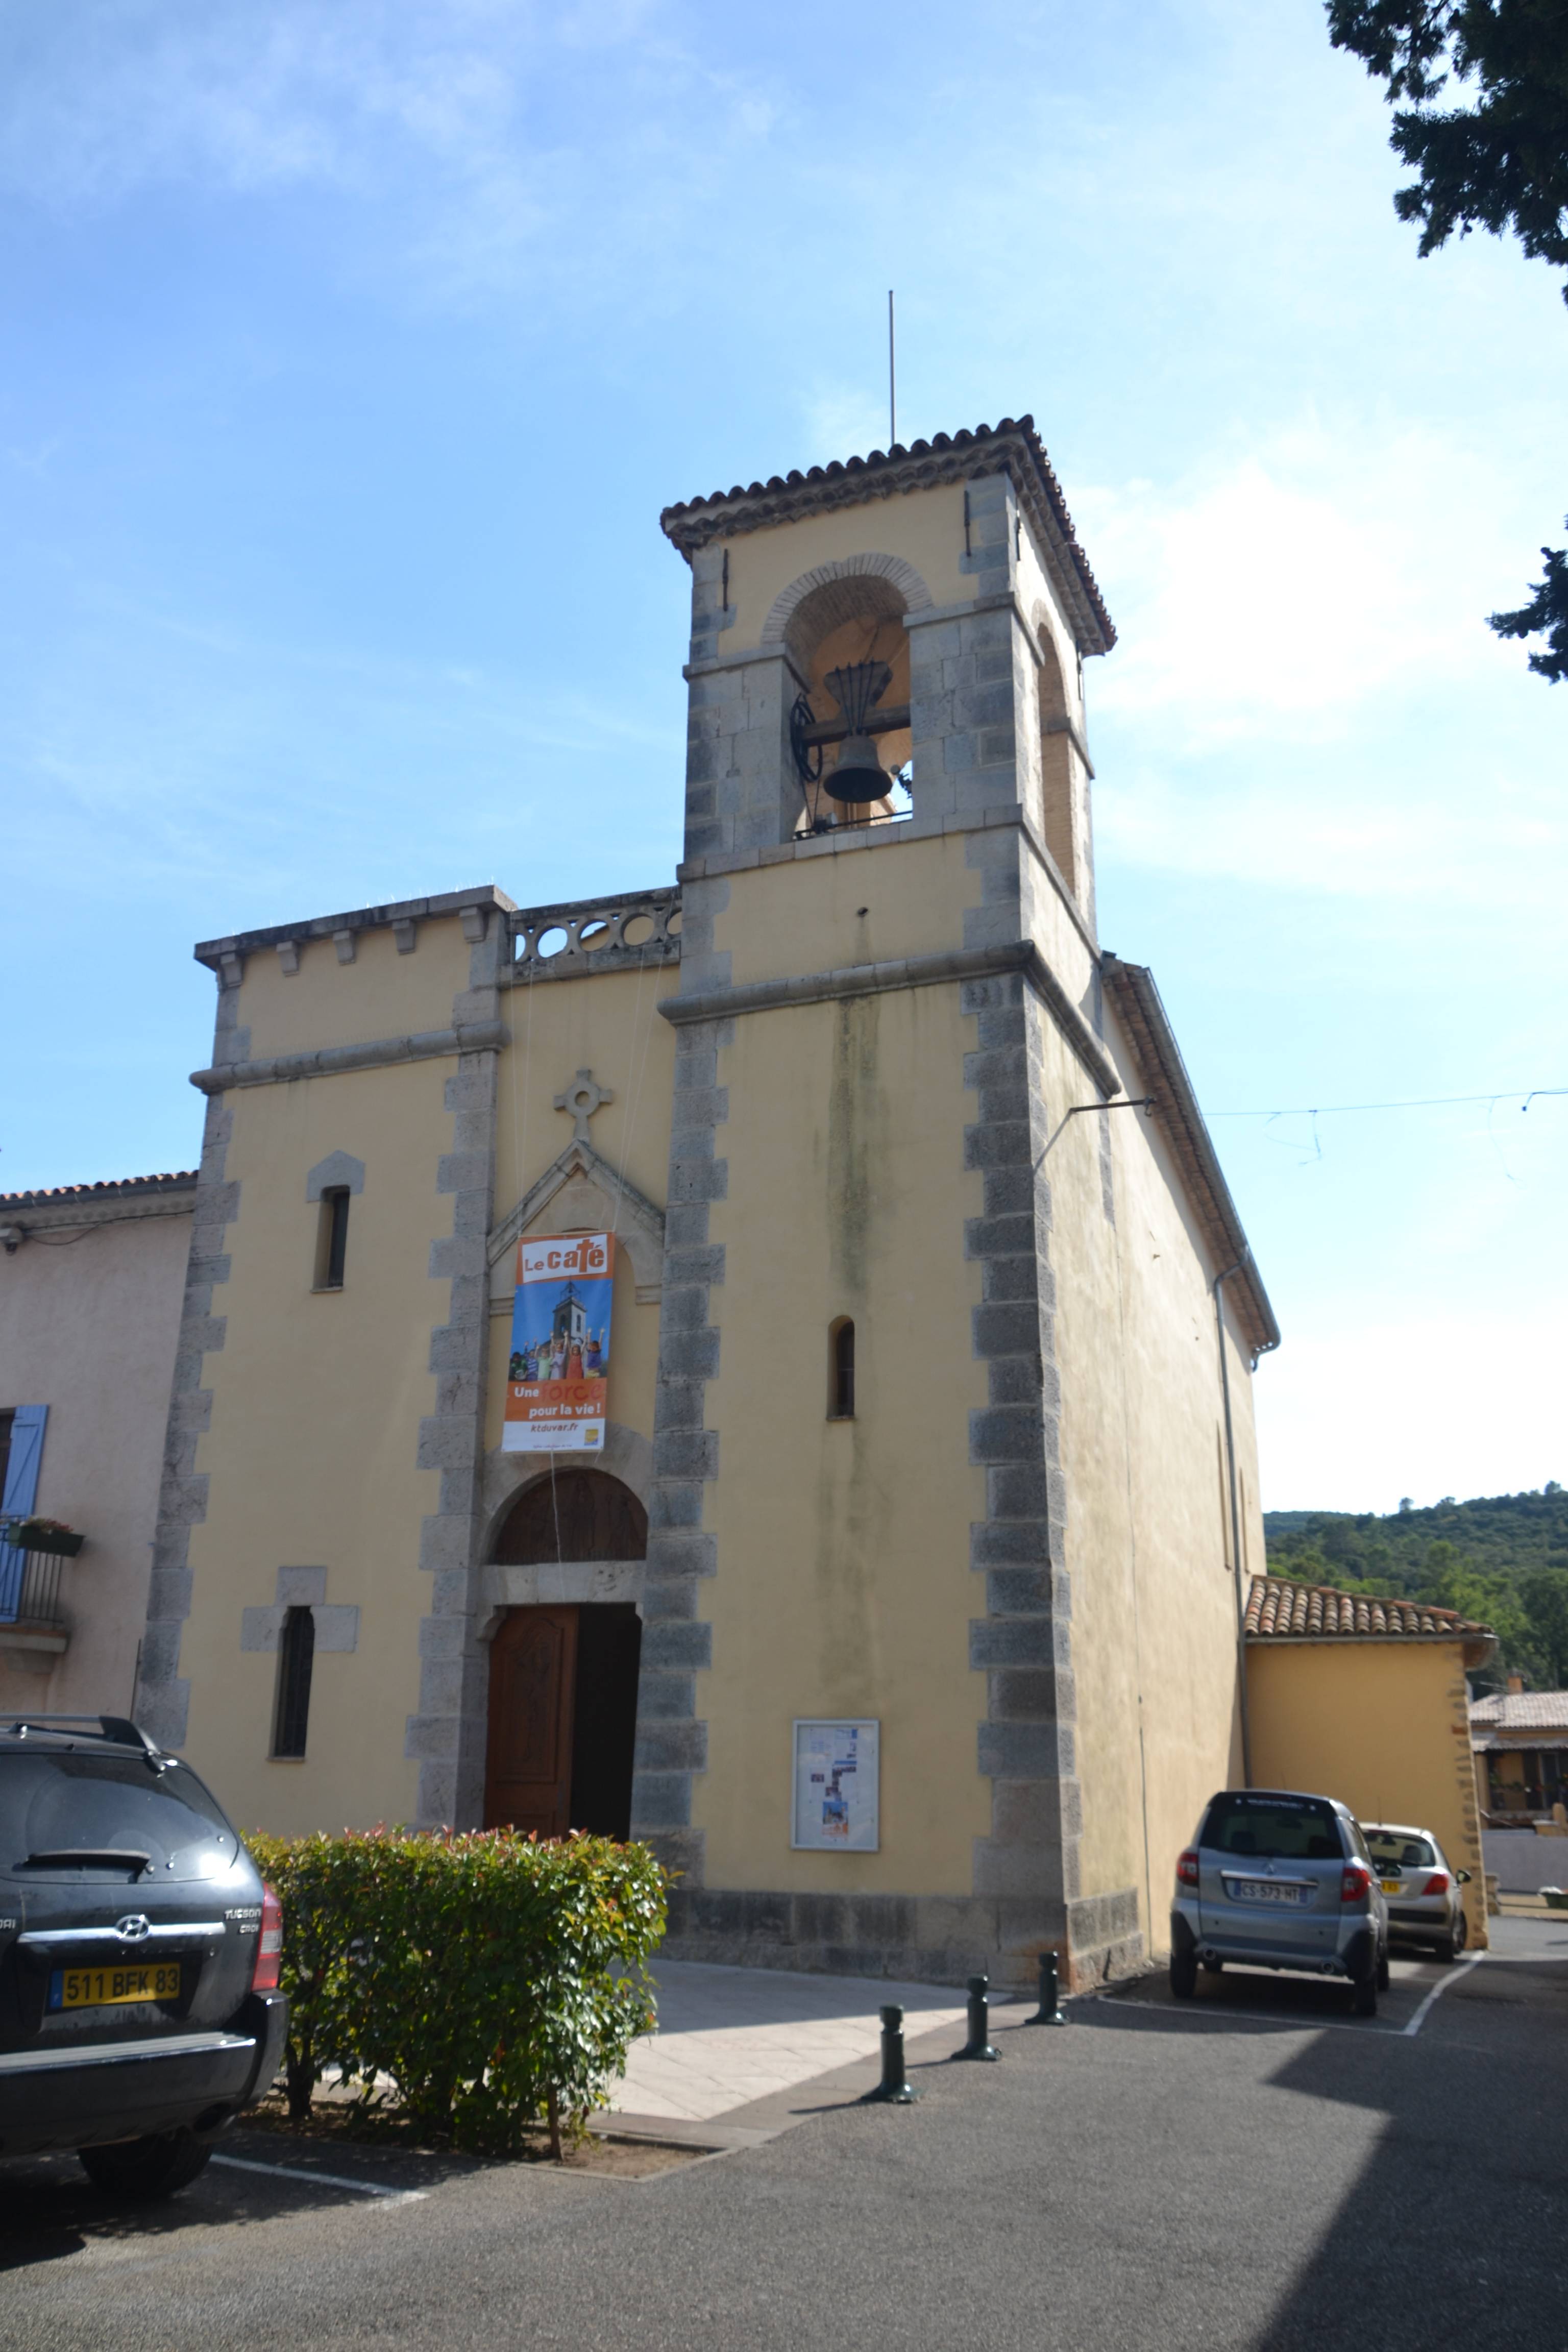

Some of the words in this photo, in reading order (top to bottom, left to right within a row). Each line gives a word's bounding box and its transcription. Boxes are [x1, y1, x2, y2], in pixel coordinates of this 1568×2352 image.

[525, 1259, 544, 1271] Le
[547, 1239, 604, 1273] caté
[514, 1386, 540, 1398] Une
[542, 1382, 602, 1402] force
[529, 1406, 557, 1419] pour
[560, 1403, 572, 1415] la
[530, 1423, 578, 1433] ktduvar.fr
[225, 1908, 262, 1920] TUCSON
[66, 1973, 105, 2000] 511
[112, 1970, 149, 1997] BFK
[155, 1968, 178, 1993] 83
